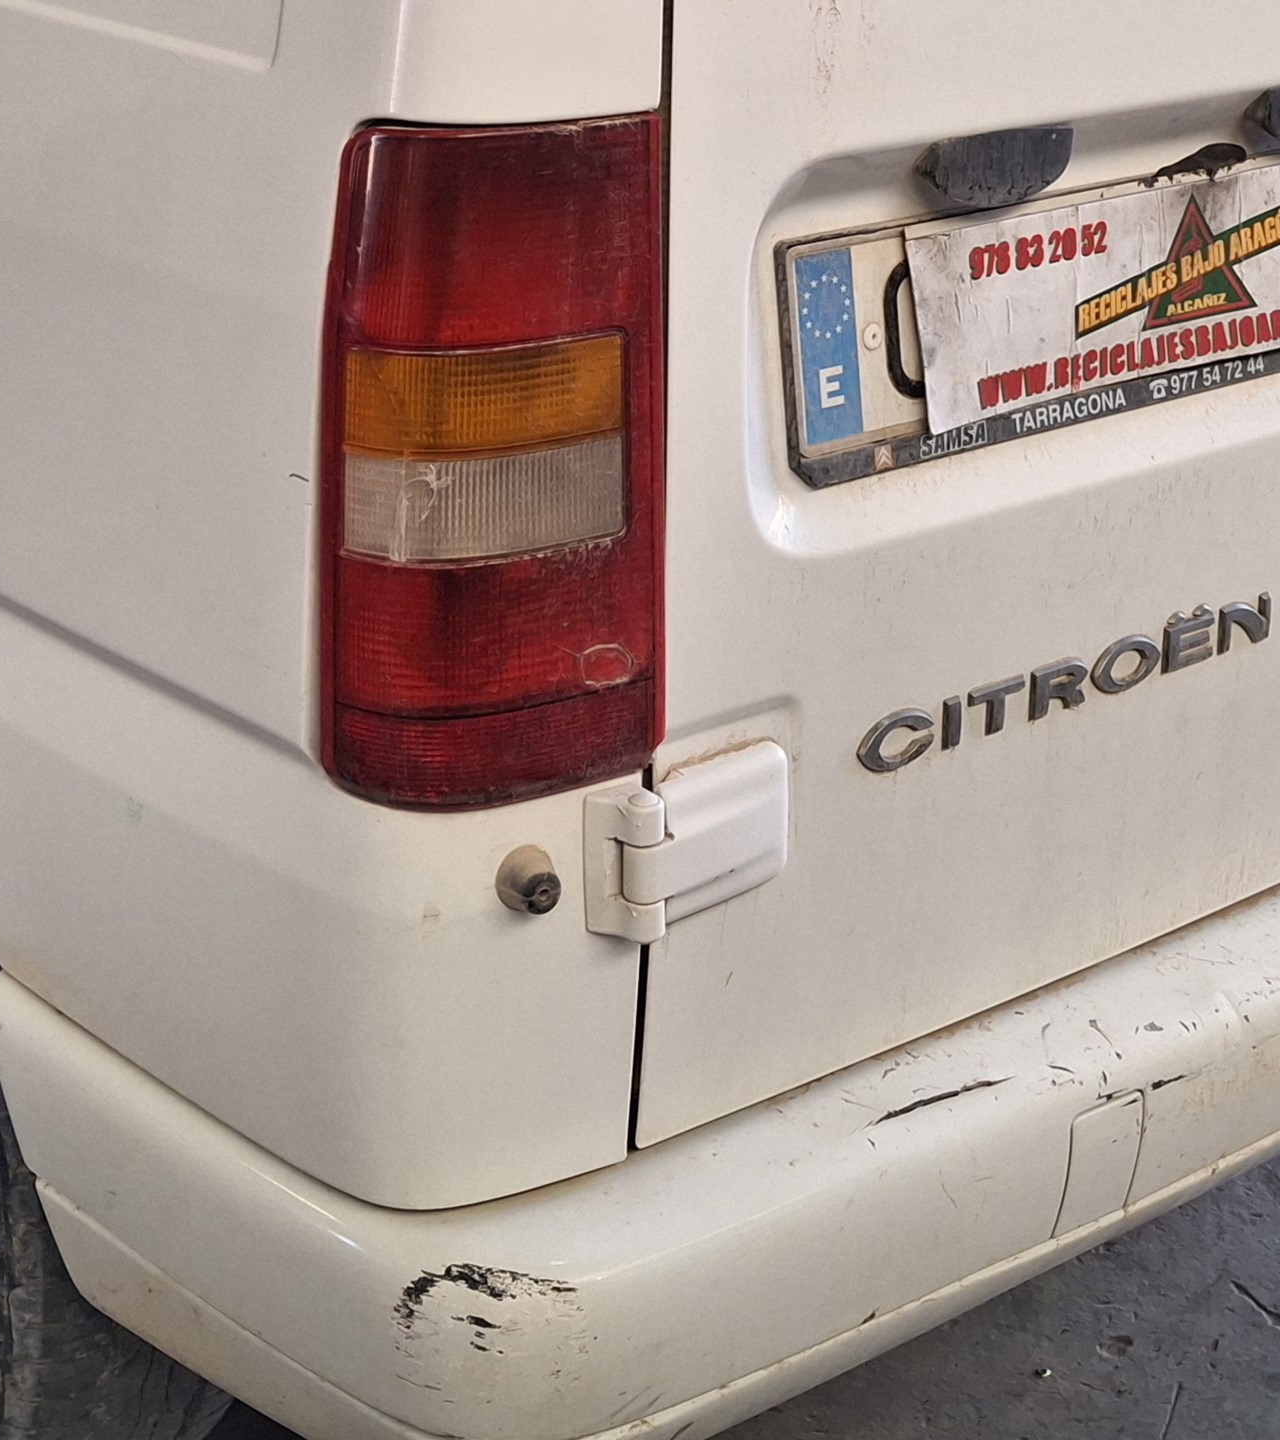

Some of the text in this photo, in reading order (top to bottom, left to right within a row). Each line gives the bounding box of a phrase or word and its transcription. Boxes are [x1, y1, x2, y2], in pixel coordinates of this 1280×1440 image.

[969, 221, 1108, 281] 978 83 20 52
[1077, 262, 1178, 333] RECICLAJES
[1181, 239, 1225, 283] BAJO
[1166, 292, 1228, 317] ALCAÑIZ
[819, 364, 846, 409] E
[920, 420, 988, 457] SAMSA
[1011, 388, 1127, 434] TARRAGONA
[1171, 371, 1197, 395] 977
[1202, 366, 1221, 387] 54
[1224, 360, 1244, 381] 72
[1246, 354, 1265, 375] 44
[856, 591, 1272, 773] CITROËN
